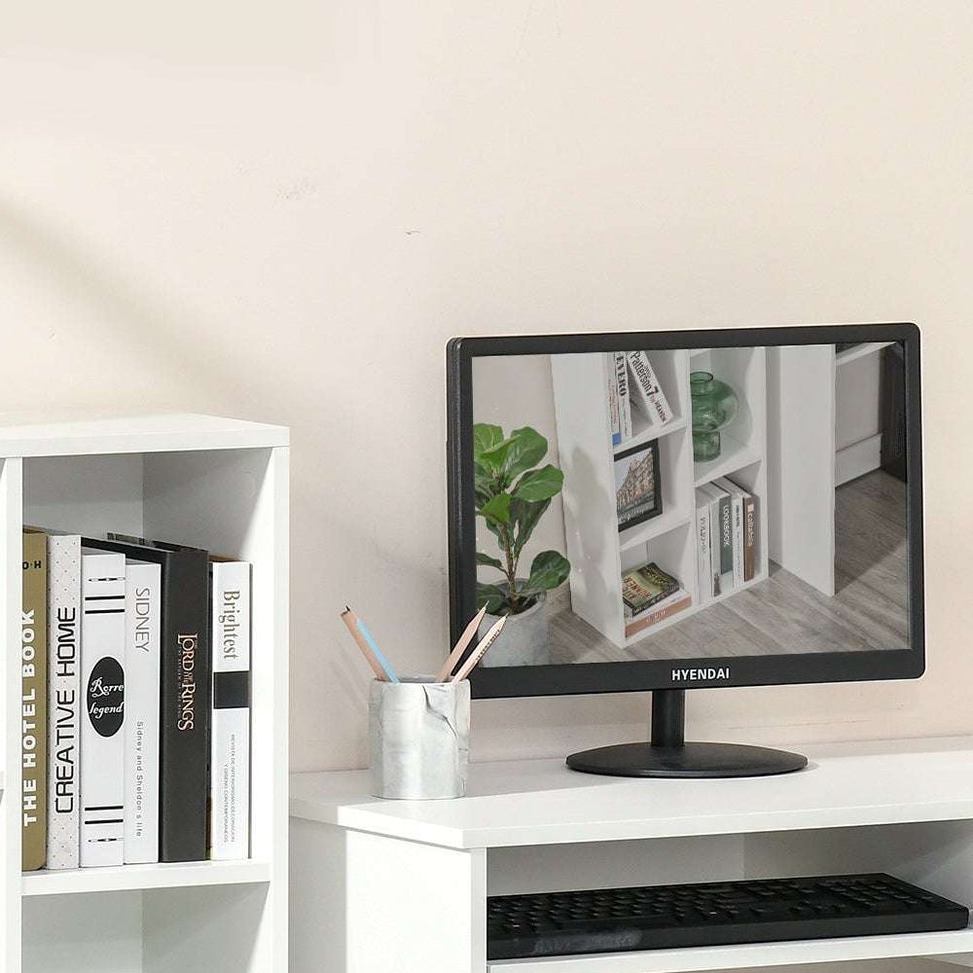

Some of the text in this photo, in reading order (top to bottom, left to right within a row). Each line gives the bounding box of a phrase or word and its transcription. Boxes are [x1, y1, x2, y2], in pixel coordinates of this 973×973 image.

[135, 587, 150, 653] SIDNEY
[218, 591, 240, 659] Brightest
[177, 633, 198, 671] LORD
[671, 667, 730, 681] HYENDAI
[22, 608, 37, 828] THE HOTEL BOOK
[55, 607, 76, 814] CREATIVE HOME
[89, 701, 125, 720] legend
[177, 683, 196, 731] RINGS
[136, 721, 144, 752] Sidney
[136, 755, 144, 772] and
[135, 774, 144, 811] Sheldon
[135, 822, 143, 837] life
